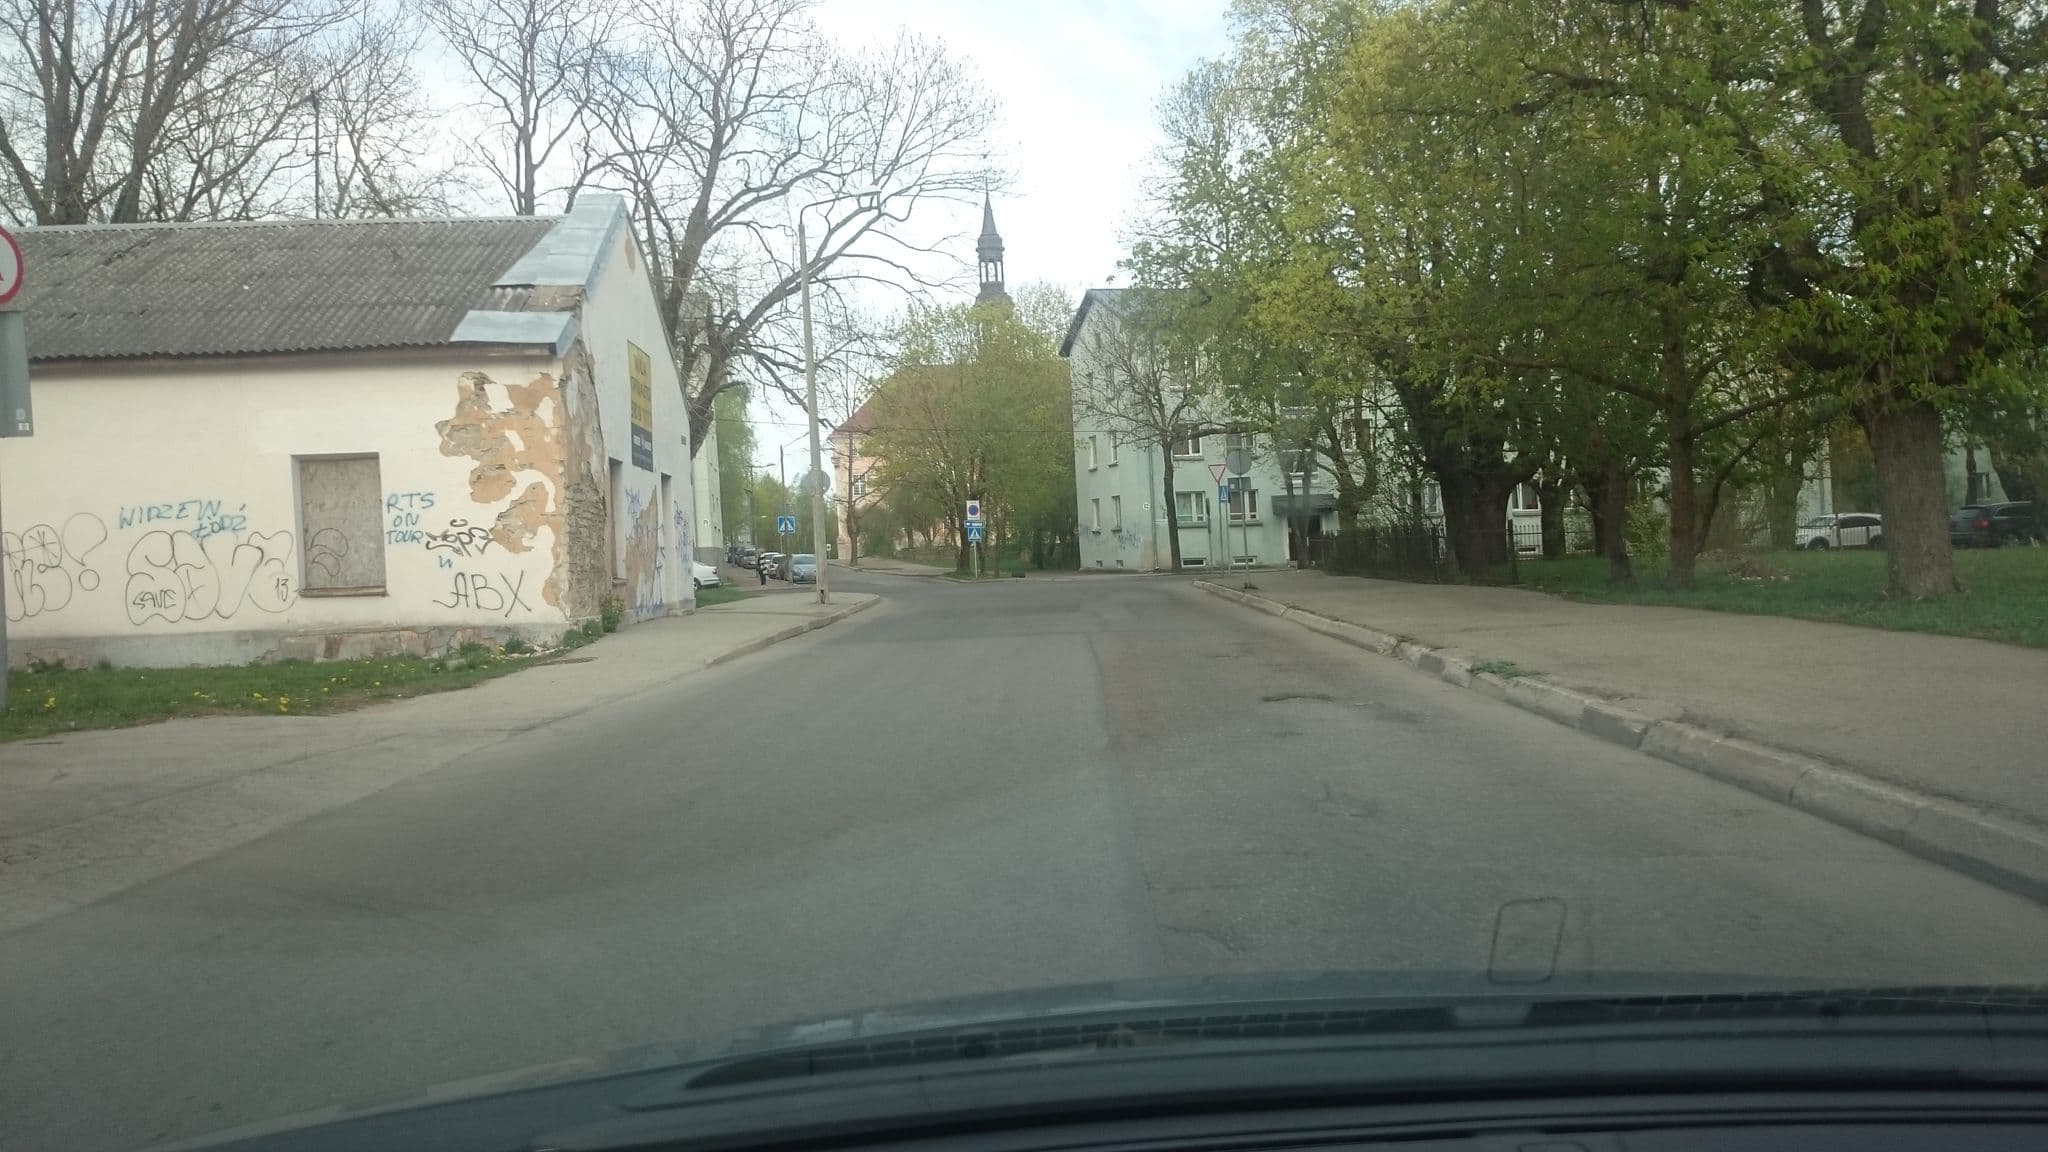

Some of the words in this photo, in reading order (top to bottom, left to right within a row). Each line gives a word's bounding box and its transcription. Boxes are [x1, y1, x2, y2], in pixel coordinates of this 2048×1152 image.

[386, 492, 435, 512] RTS
[393, 515, 419, 528] ON
[386, 530, 424, 545] TOUR
[432, 570, 532, 618] ABX
